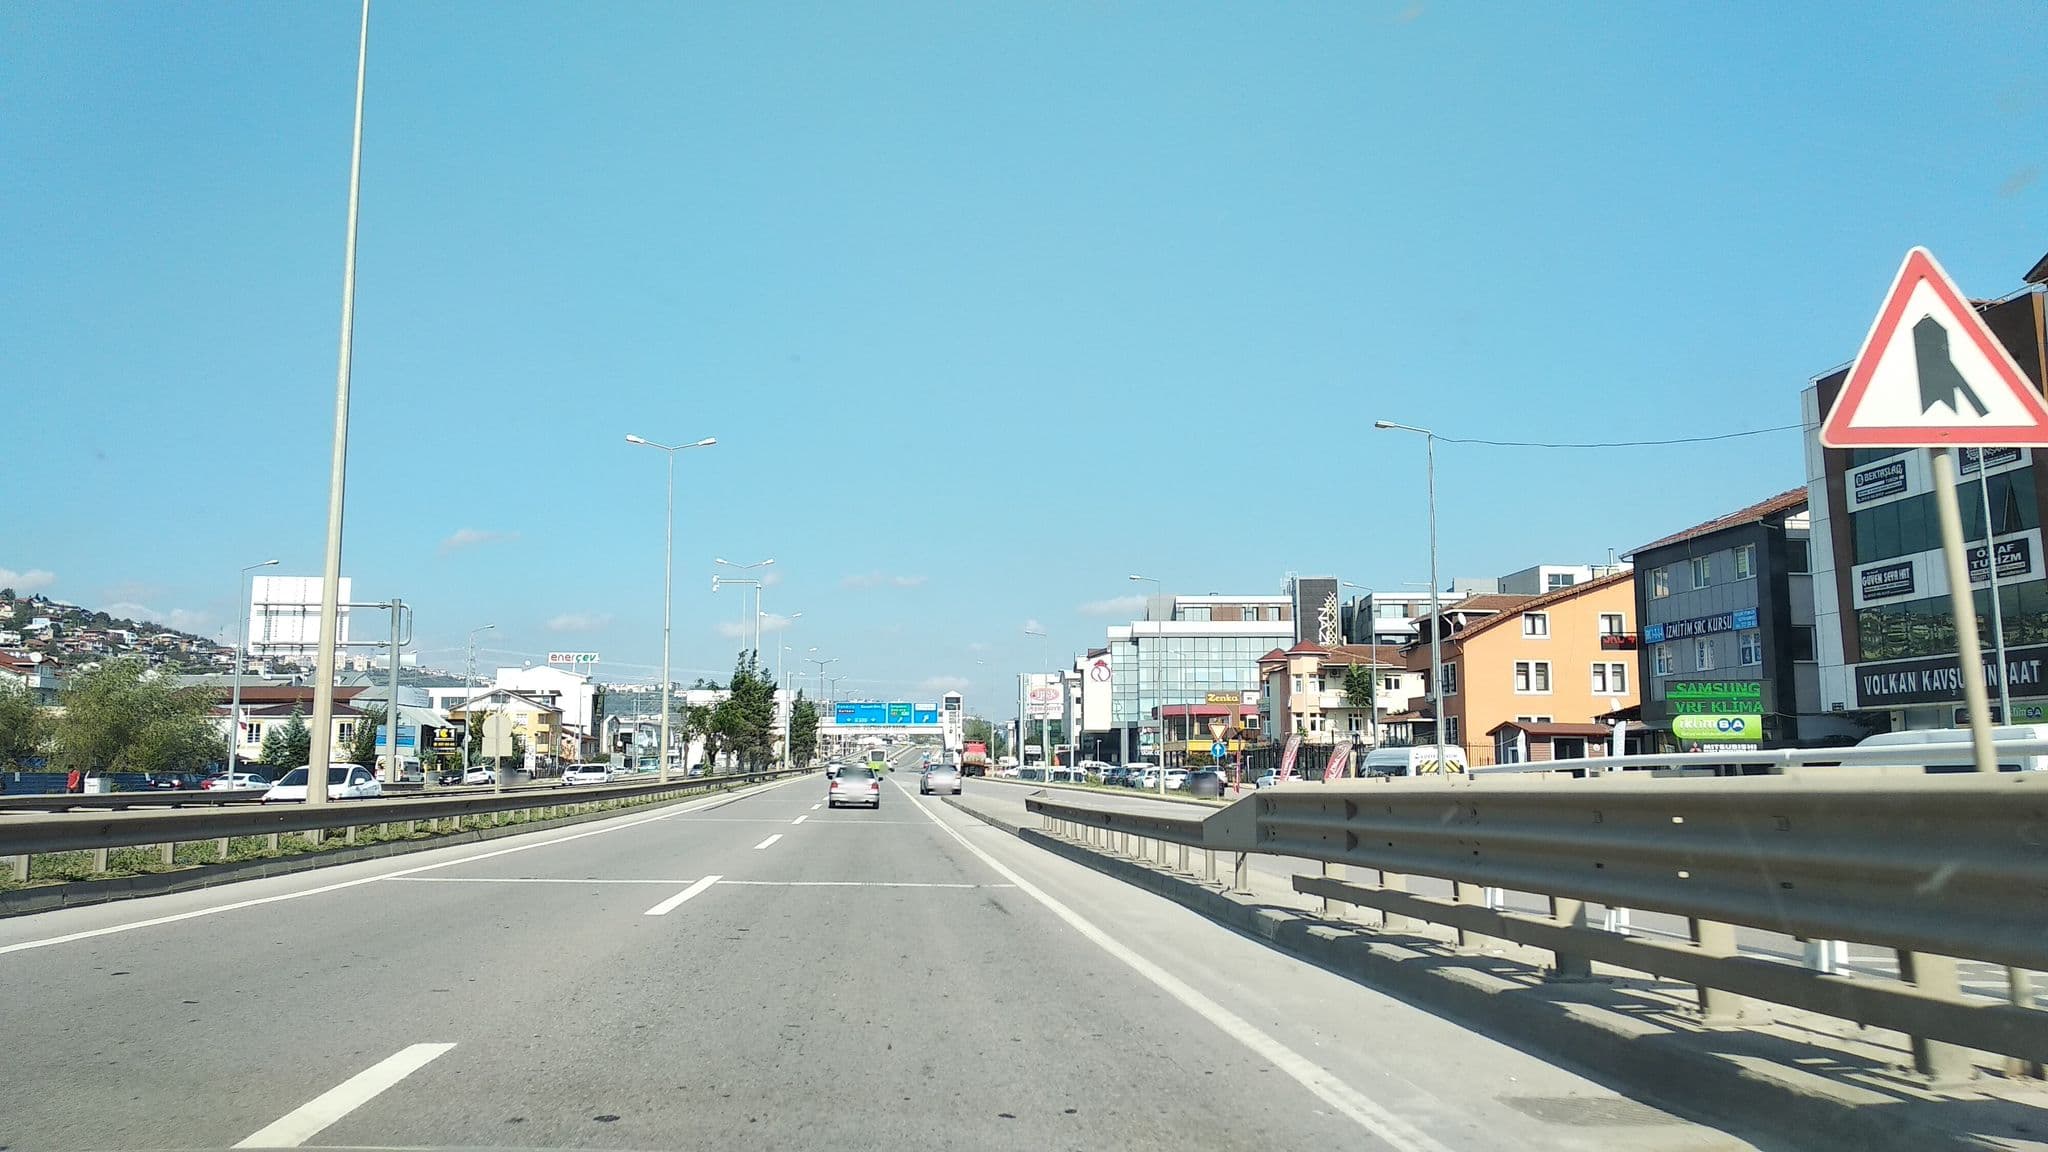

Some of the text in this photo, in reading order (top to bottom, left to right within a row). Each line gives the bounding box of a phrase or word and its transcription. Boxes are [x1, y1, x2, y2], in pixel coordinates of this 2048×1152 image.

[1970, 552, 2022, 569] TUİZM
[1693, 619, 1707, 635] SRC
[1707, 614, 1733, 632] KURSU
[550, 654, 597, 664] enerçev
[1863, 659, 2042, 697] VOLKAN KAVŞU İNAAT
[1675, 682, 1760, 694] SAMSUNG
[1207, 693, 1239, 703] Zenka
[1675, 697, 1764, 713] VRF KLİMA
